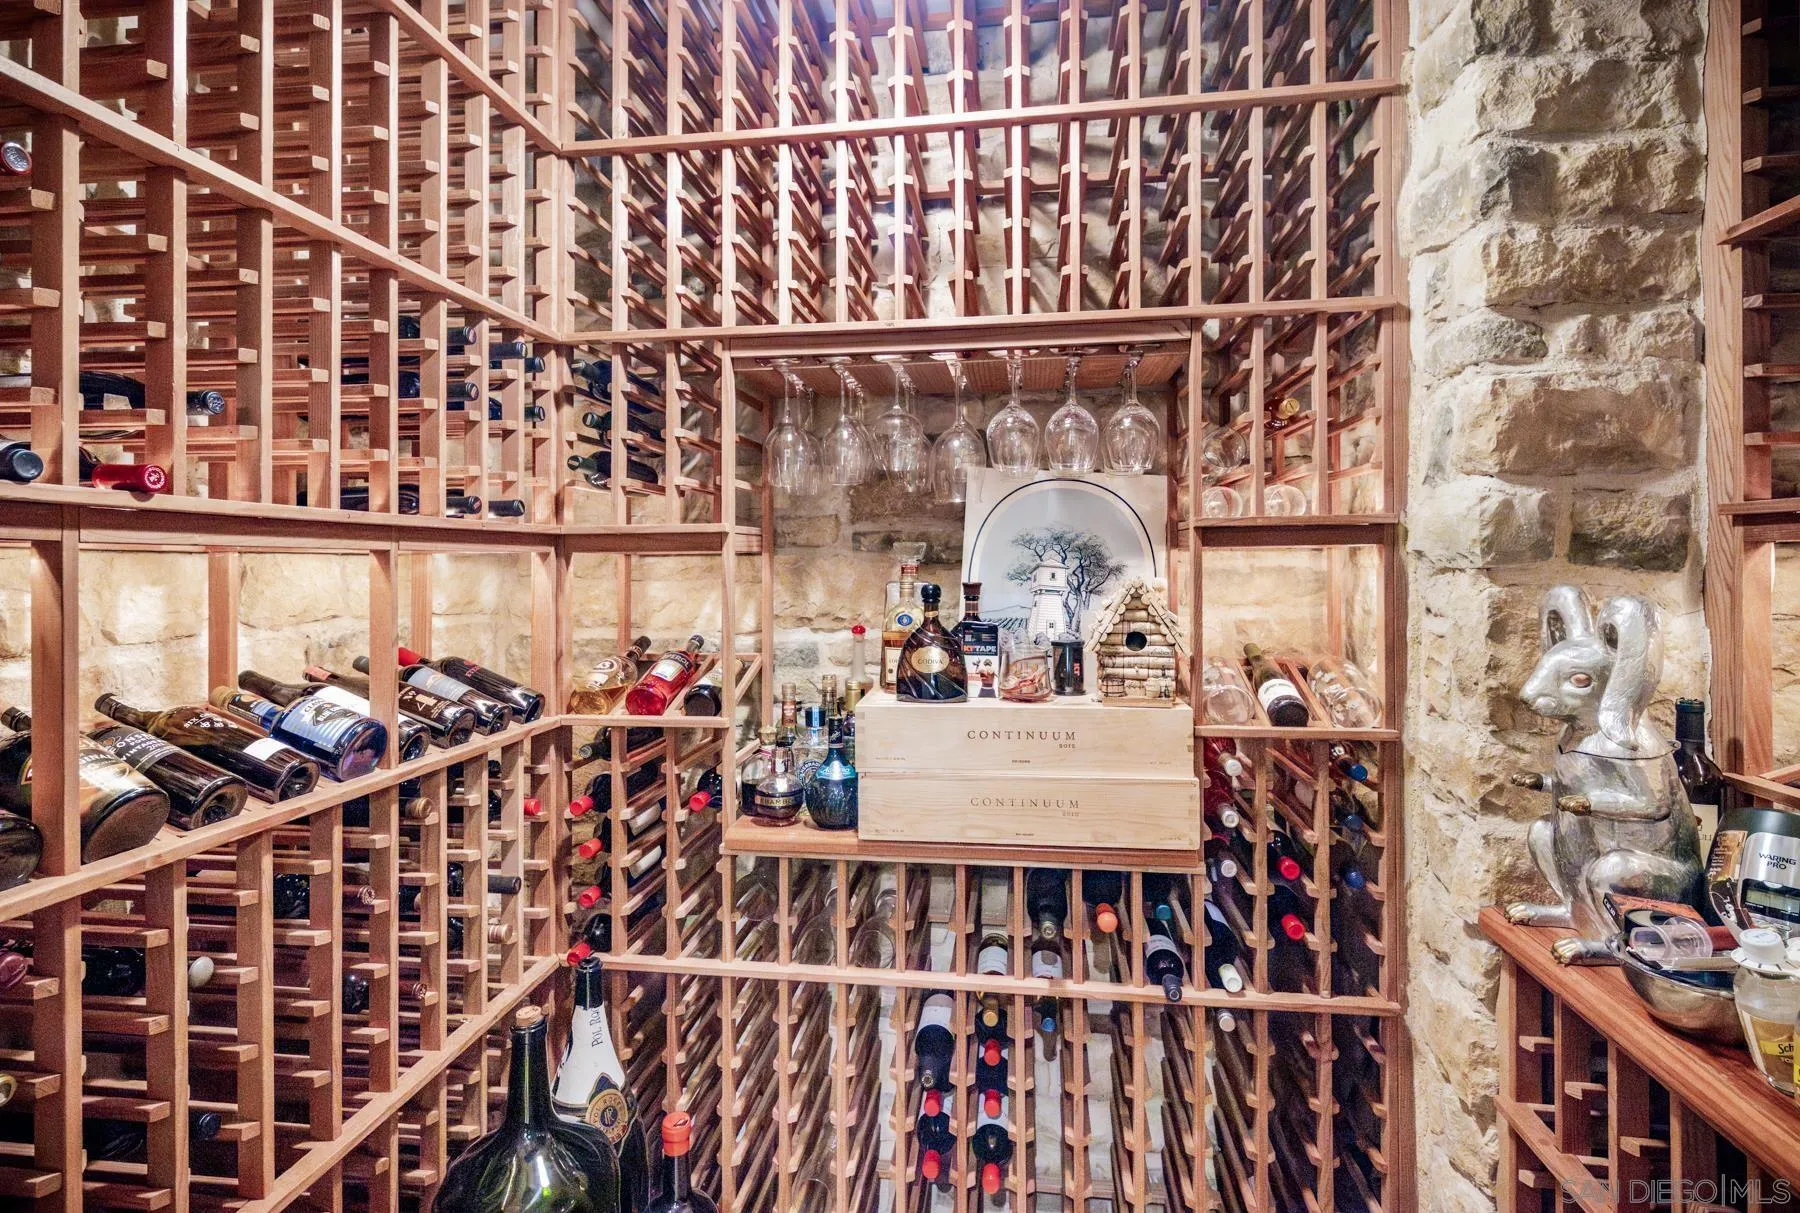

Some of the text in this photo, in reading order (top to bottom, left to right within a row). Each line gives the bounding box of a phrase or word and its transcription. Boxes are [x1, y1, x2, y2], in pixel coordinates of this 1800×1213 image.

[967, 730, 1076, 741] CONTINUUM
[970, 797, 1079, 809] CONTINUUM
[1758, 852, 1797, 866] WARING
[1766, 861, 1787, 870] PRO
[1778, 1043, 1794, 1054] Sch
